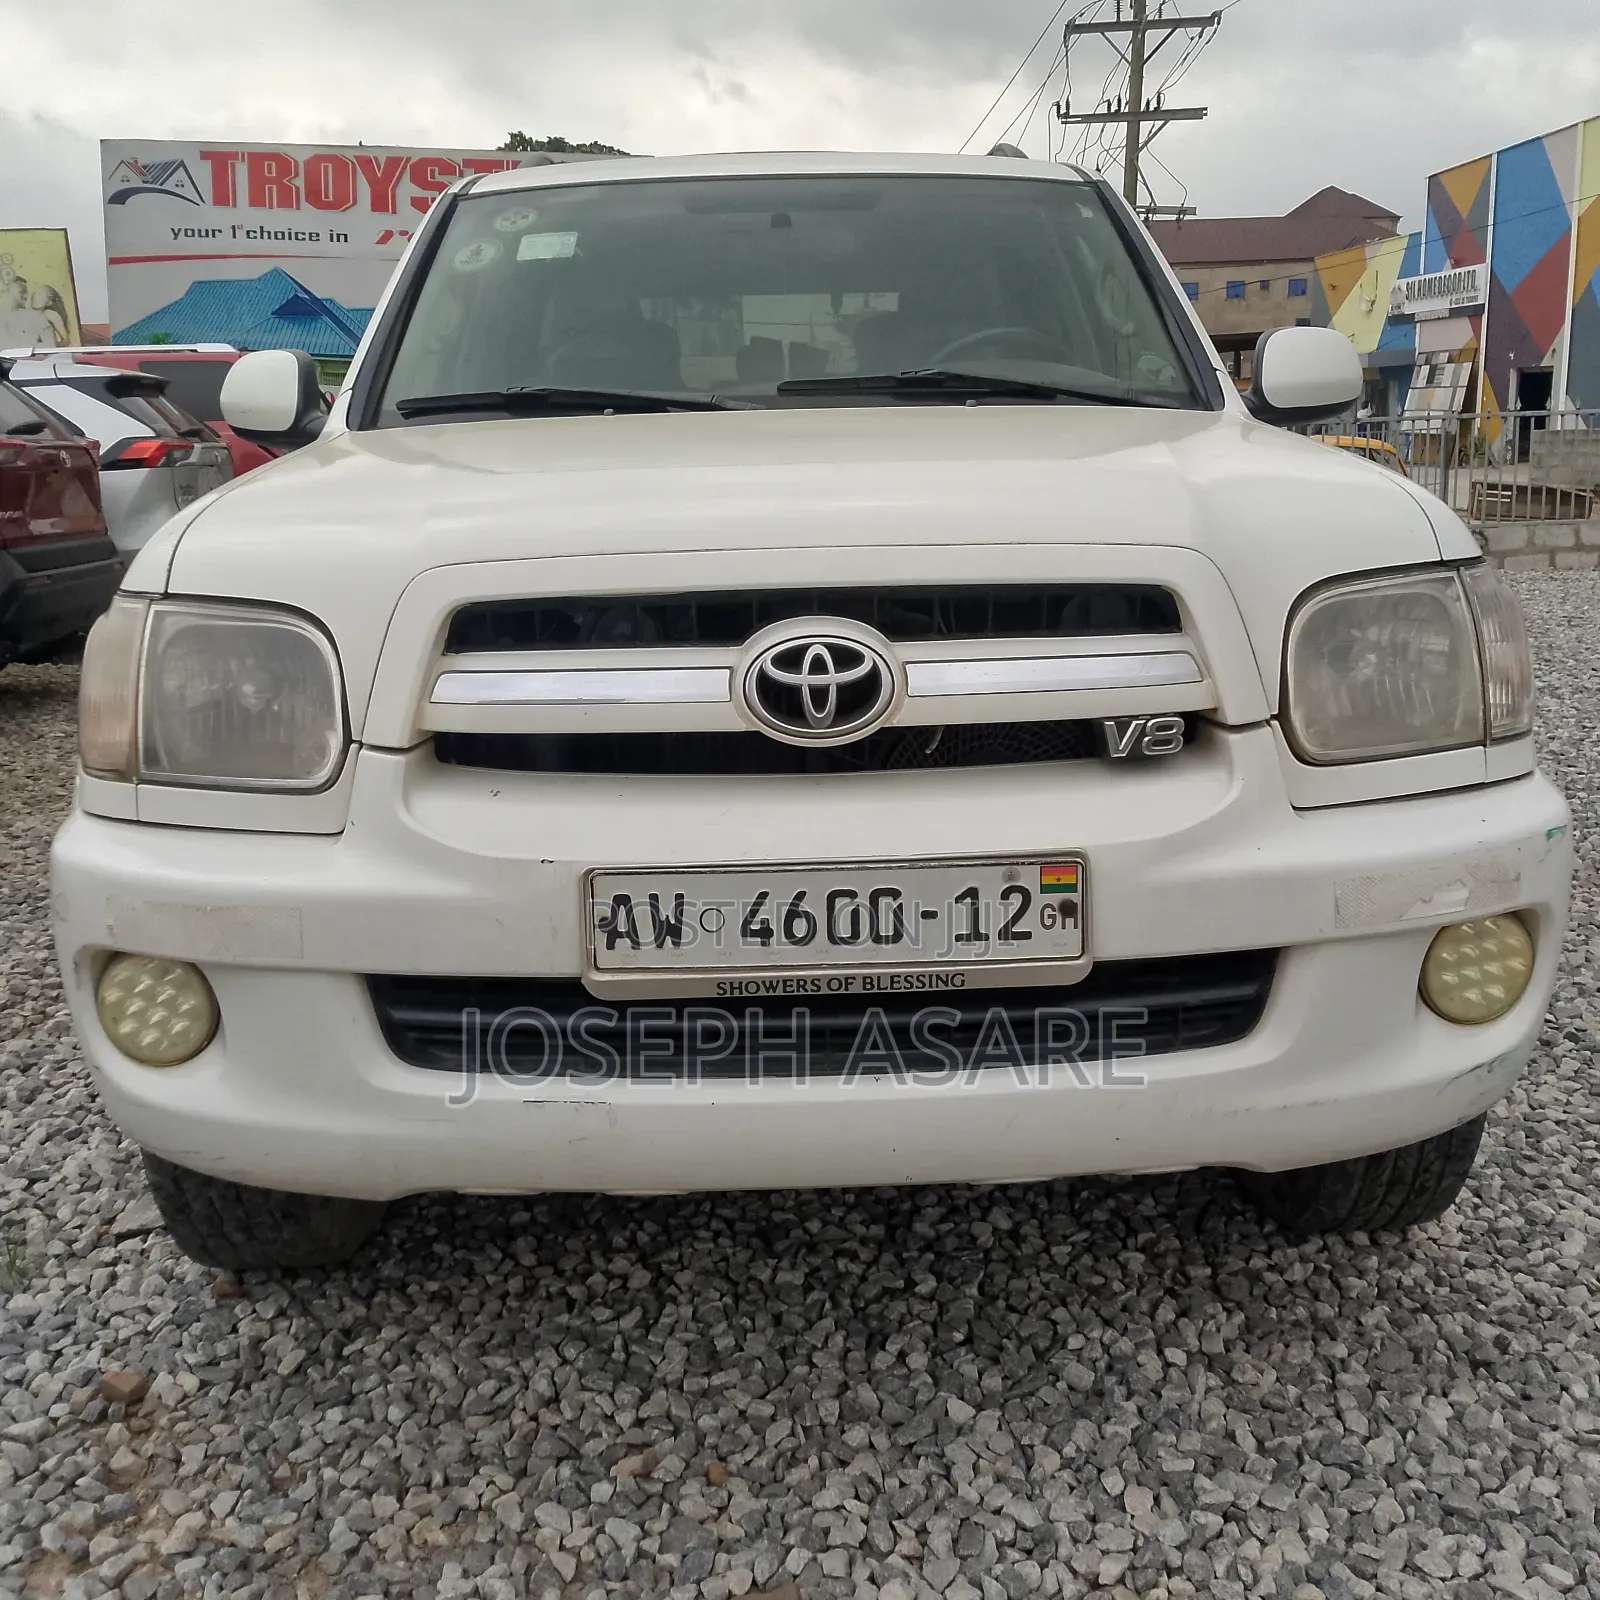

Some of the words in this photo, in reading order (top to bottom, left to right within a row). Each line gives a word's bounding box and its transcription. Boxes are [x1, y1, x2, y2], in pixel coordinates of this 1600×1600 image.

[170, 226, 223, 241] your
[245, 225, 321, 242] choice
[328, 229, 349, 243] in
[1103, 716, 1185, 758] V8
[604, 892, 685, 951] AW
[716, 977, 822, 997] SHOWERS
[826, 976, 857, 993] OF
[862, 972, 966, 991] BLESSING
